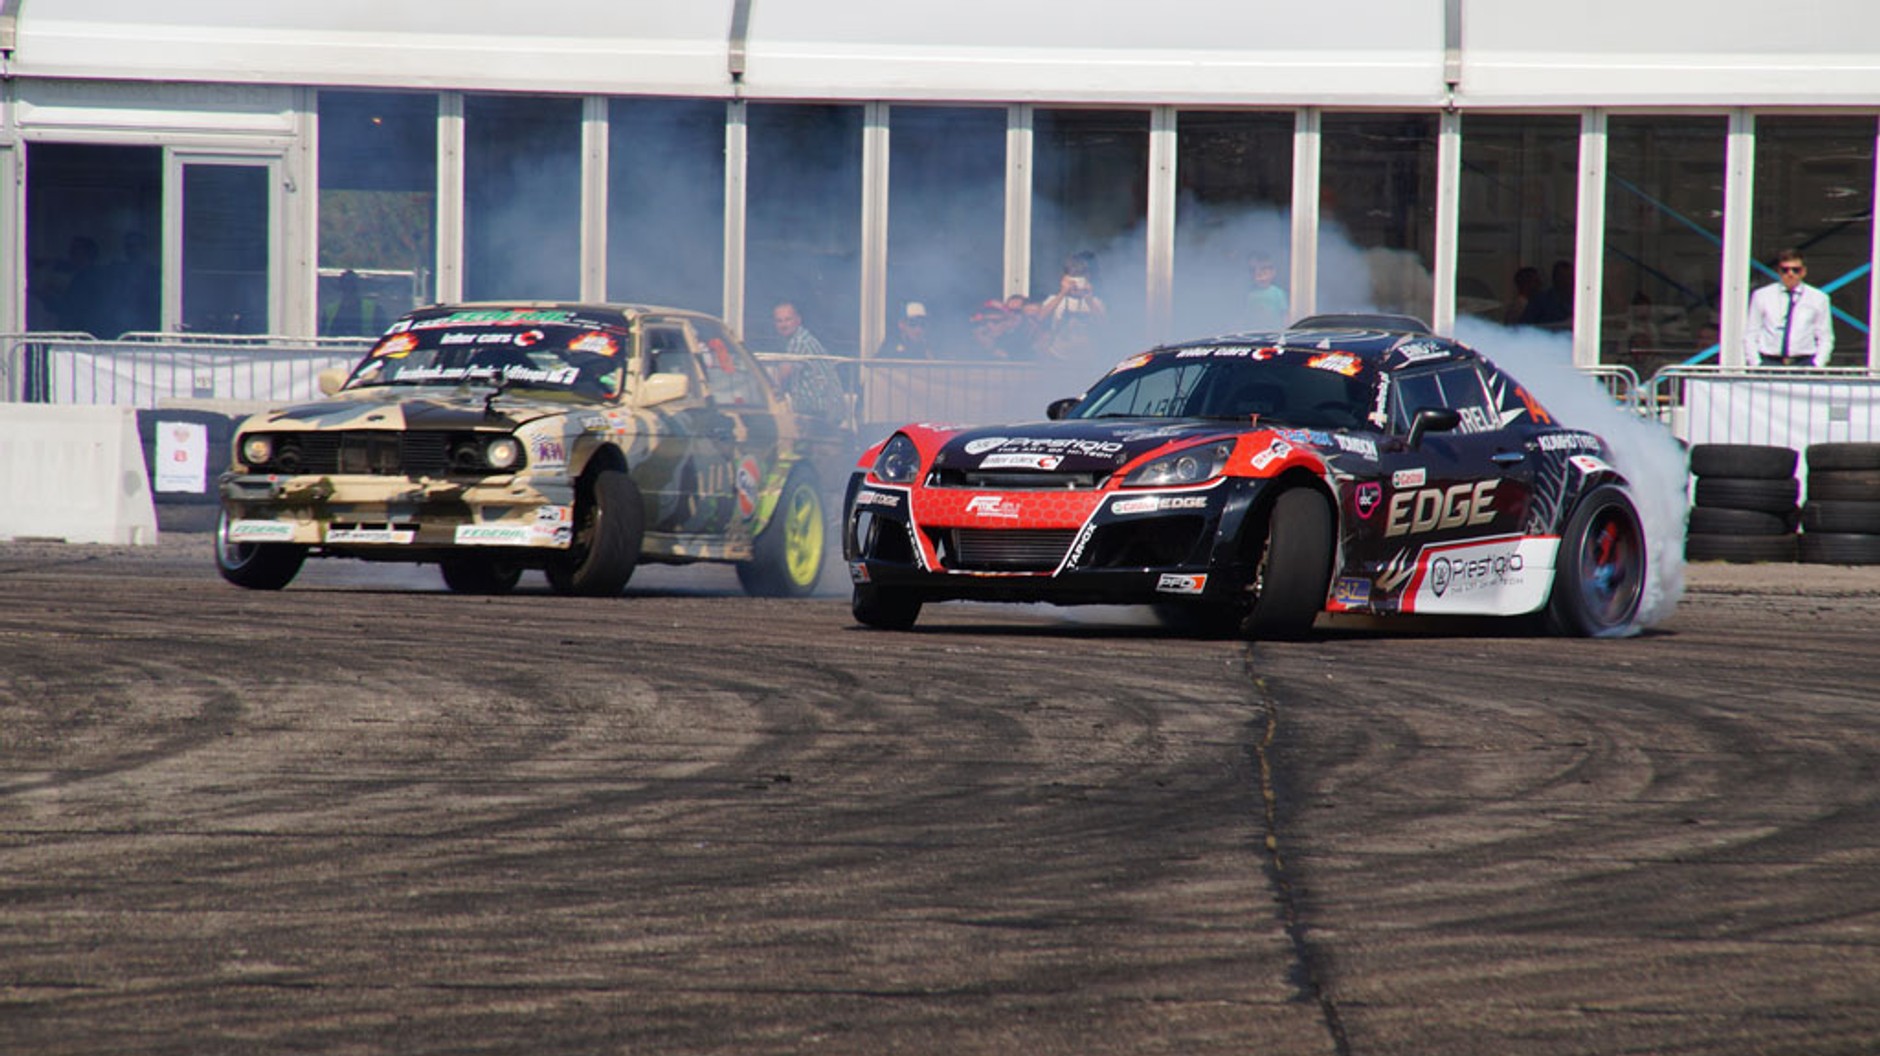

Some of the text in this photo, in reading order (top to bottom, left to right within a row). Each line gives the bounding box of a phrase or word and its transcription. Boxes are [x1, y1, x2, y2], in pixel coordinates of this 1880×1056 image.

[1514, 387, 1552, 425] 14
[1002, 437, 1123, 453] Prestigio
[1159, 496, 1208, 509] EDGE
[1384, 478, 1502, 538] EDGE
[461, 528, 527, 538] FEDERAL
[1452, 552, 1523, 582] Prestigio
